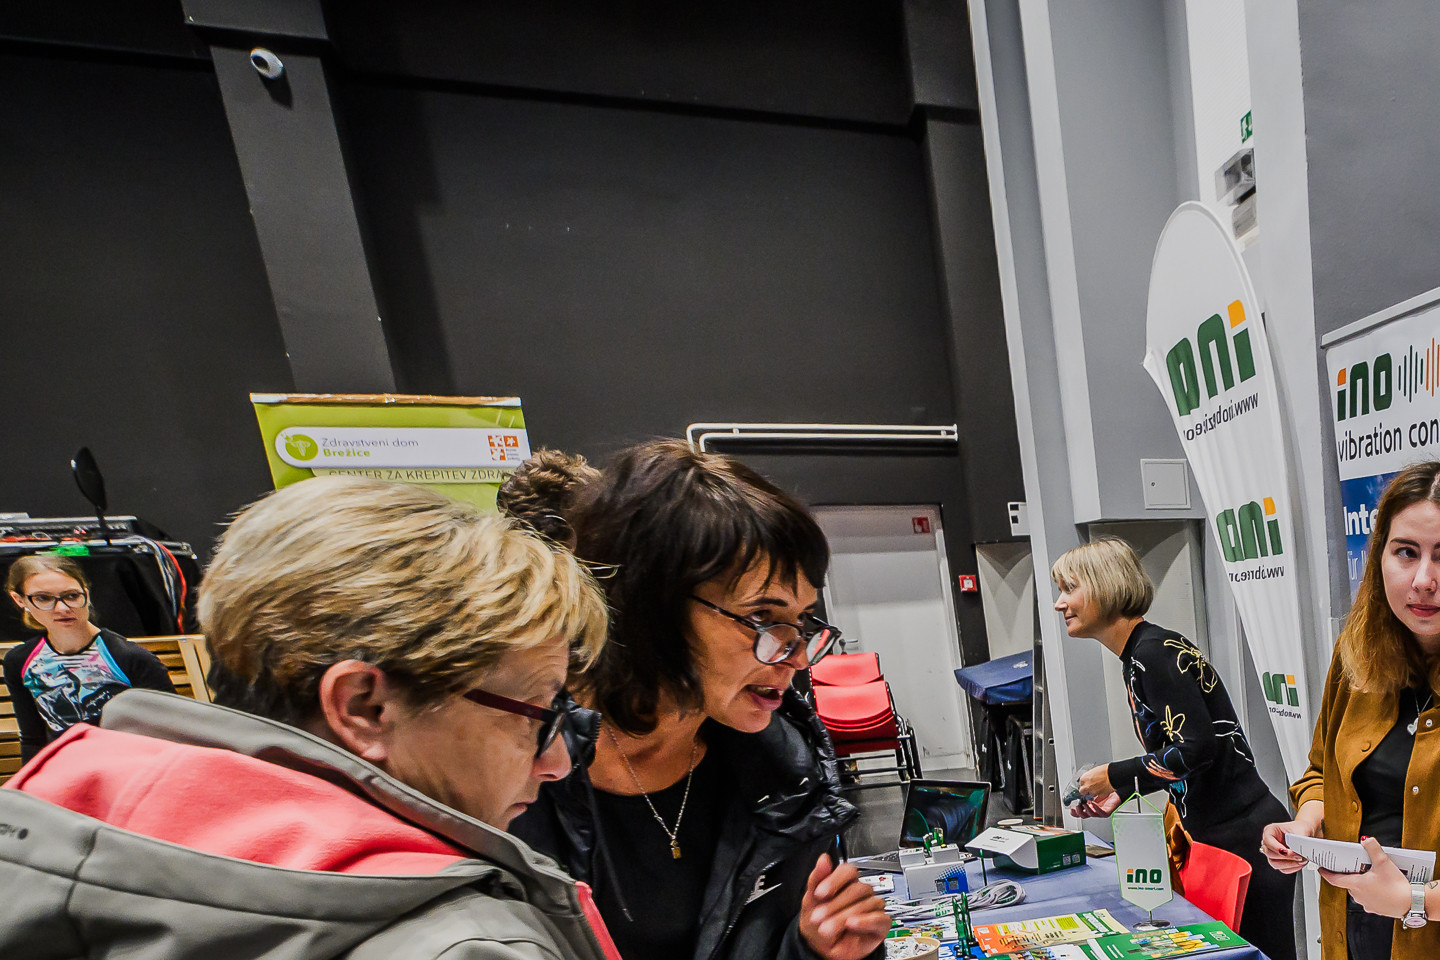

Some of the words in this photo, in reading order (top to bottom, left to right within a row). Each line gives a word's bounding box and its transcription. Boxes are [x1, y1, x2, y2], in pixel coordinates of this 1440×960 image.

[1337, 352, 1393, 422] ino
[321, 438, 389, 448] Zdravstveni
[392, 438, 419, 447] dom
[1338, 420, 1402, 462] vibration
[323, 448, 371, 457] Brežice
[387, 470, 403, 481] ZA
[407, 470, 467, 481] KREPITEV
[1126, 868, 1162, 884] ino
